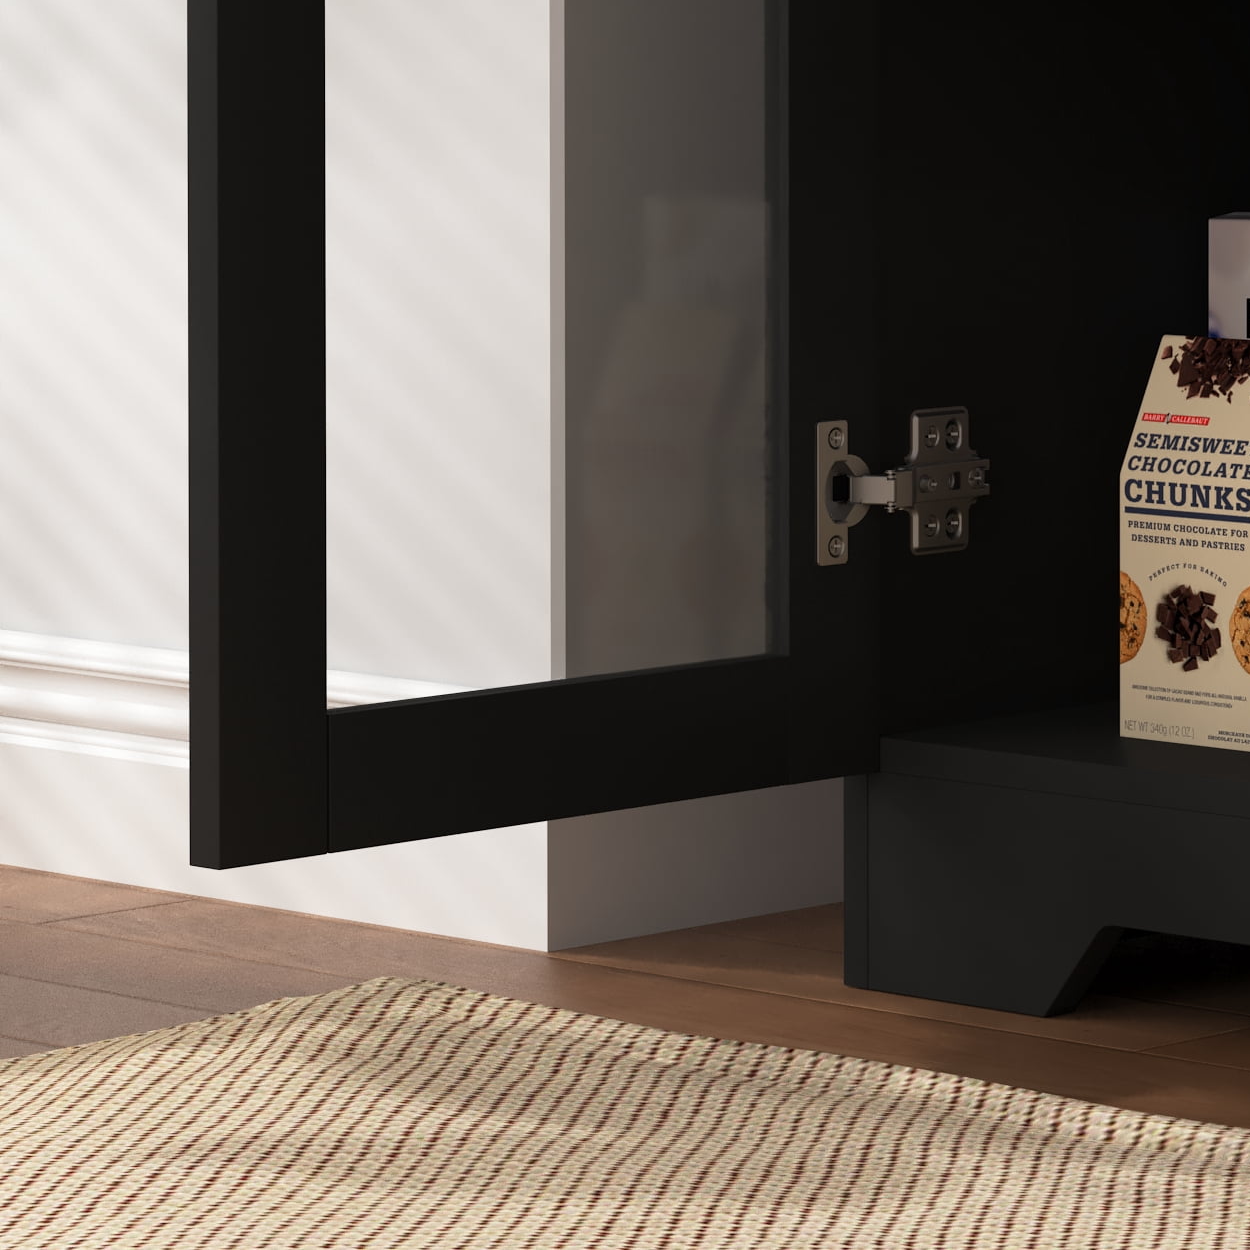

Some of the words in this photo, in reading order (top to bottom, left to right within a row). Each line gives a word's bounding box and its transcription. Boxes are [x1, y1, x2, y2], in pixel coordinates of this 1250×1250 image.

[1128, 520, 1171, 532] PREMIUM
[1174, 524, 1228, 536] CHOCOLATE
[1231, 529, 1248, 538] FOR
[1131, 534, 1176, 546] DESSERTS
[1179, 538, 1199, 548] AND
[1201, 540, 1245, 551] PASTRIES
[1149, 564, 1180, 581] PERFECT
[1200, 566, 1227, 587] BAKING
[1124, 720, 1136, 730] NET
[1138, 721, 1148, 732] WT
